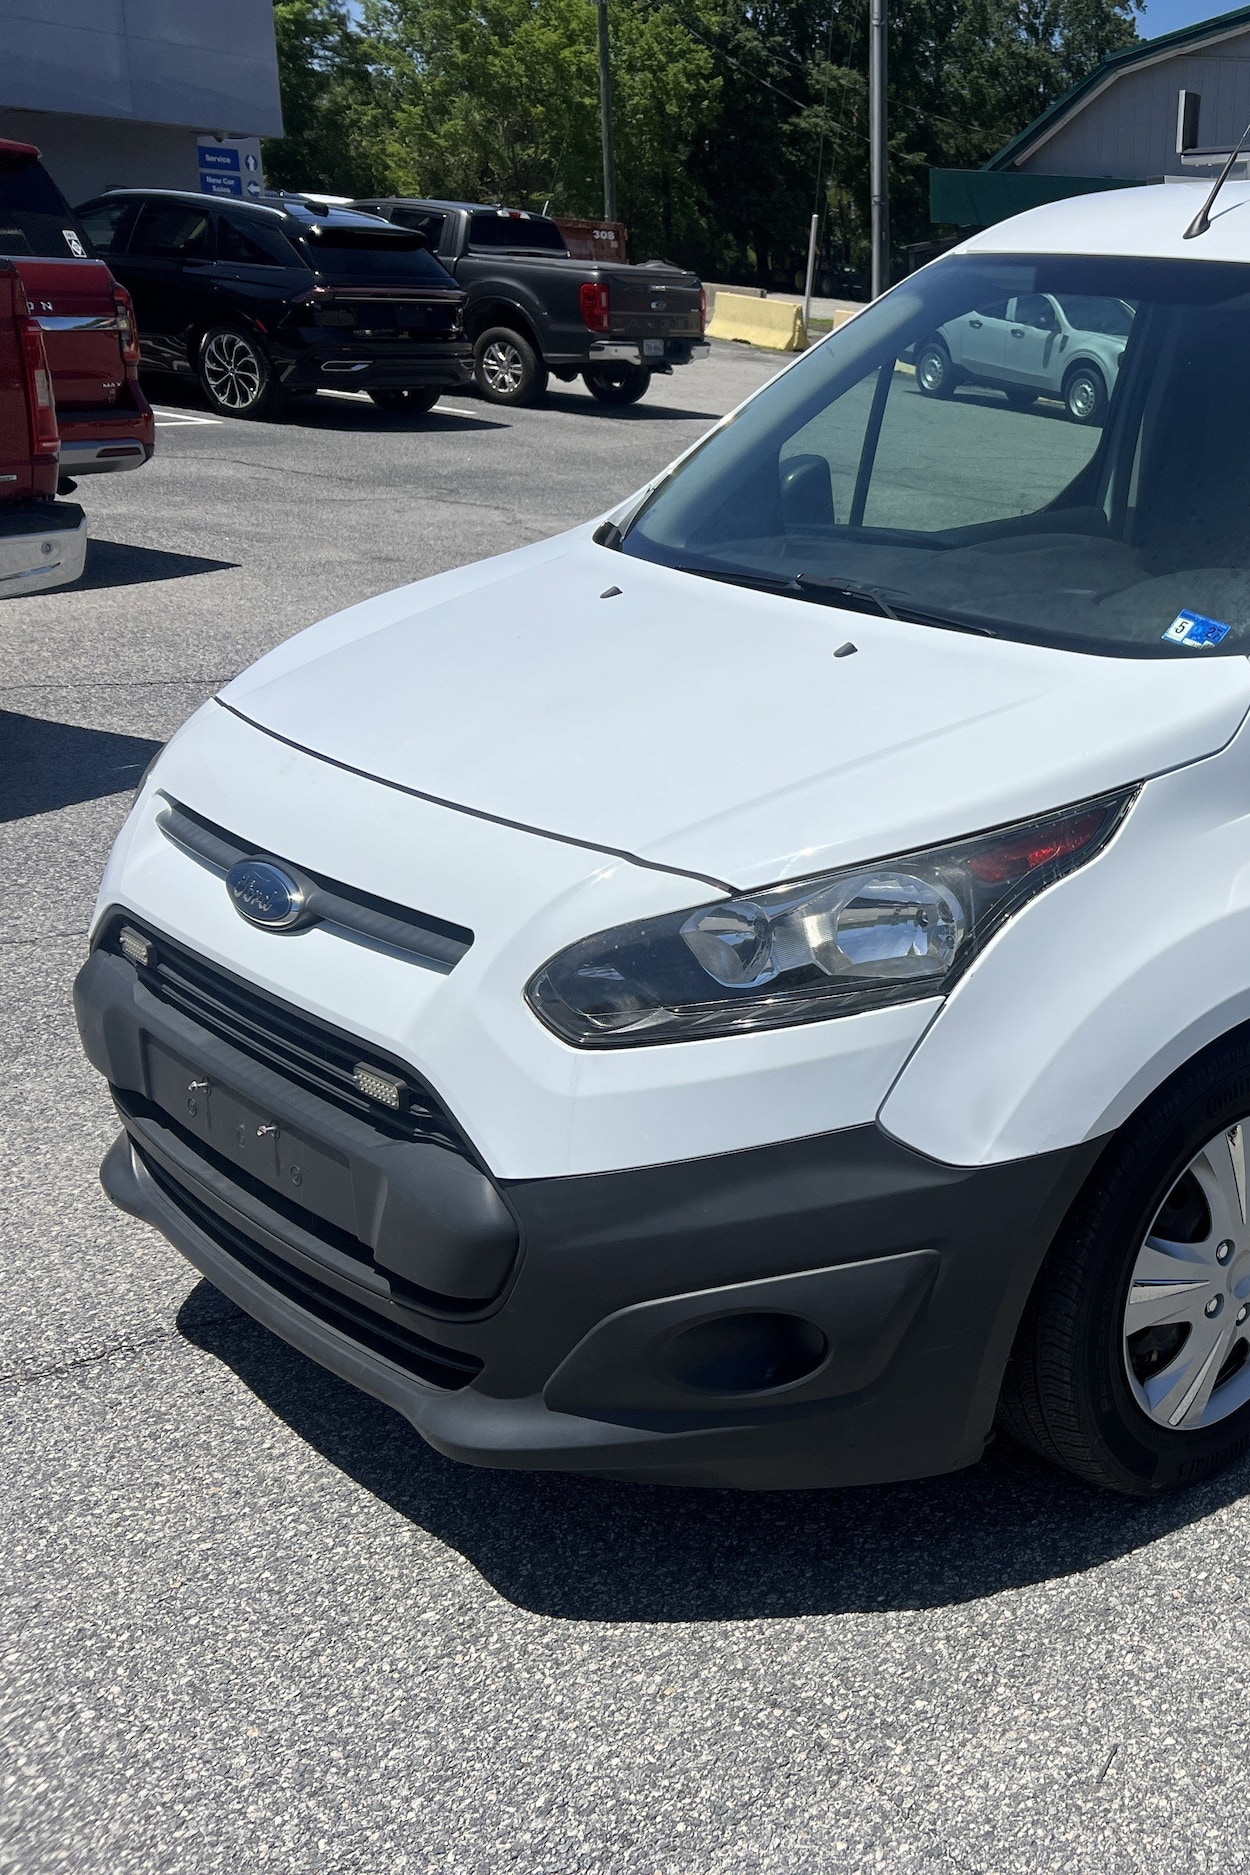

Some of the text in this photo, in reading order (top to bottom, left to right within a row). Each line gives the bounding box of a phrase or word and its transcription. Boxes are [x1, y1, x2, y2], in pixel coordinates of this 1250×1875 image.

[205, 154, 231, 164] Service
[206, 176, 222, 184] New
[212, 185, 231, 193] Sales
[593, 230, 615, 240] 308
[1175, 621, 1189, 634] 5
[234, 871, 278, 912] Ford
